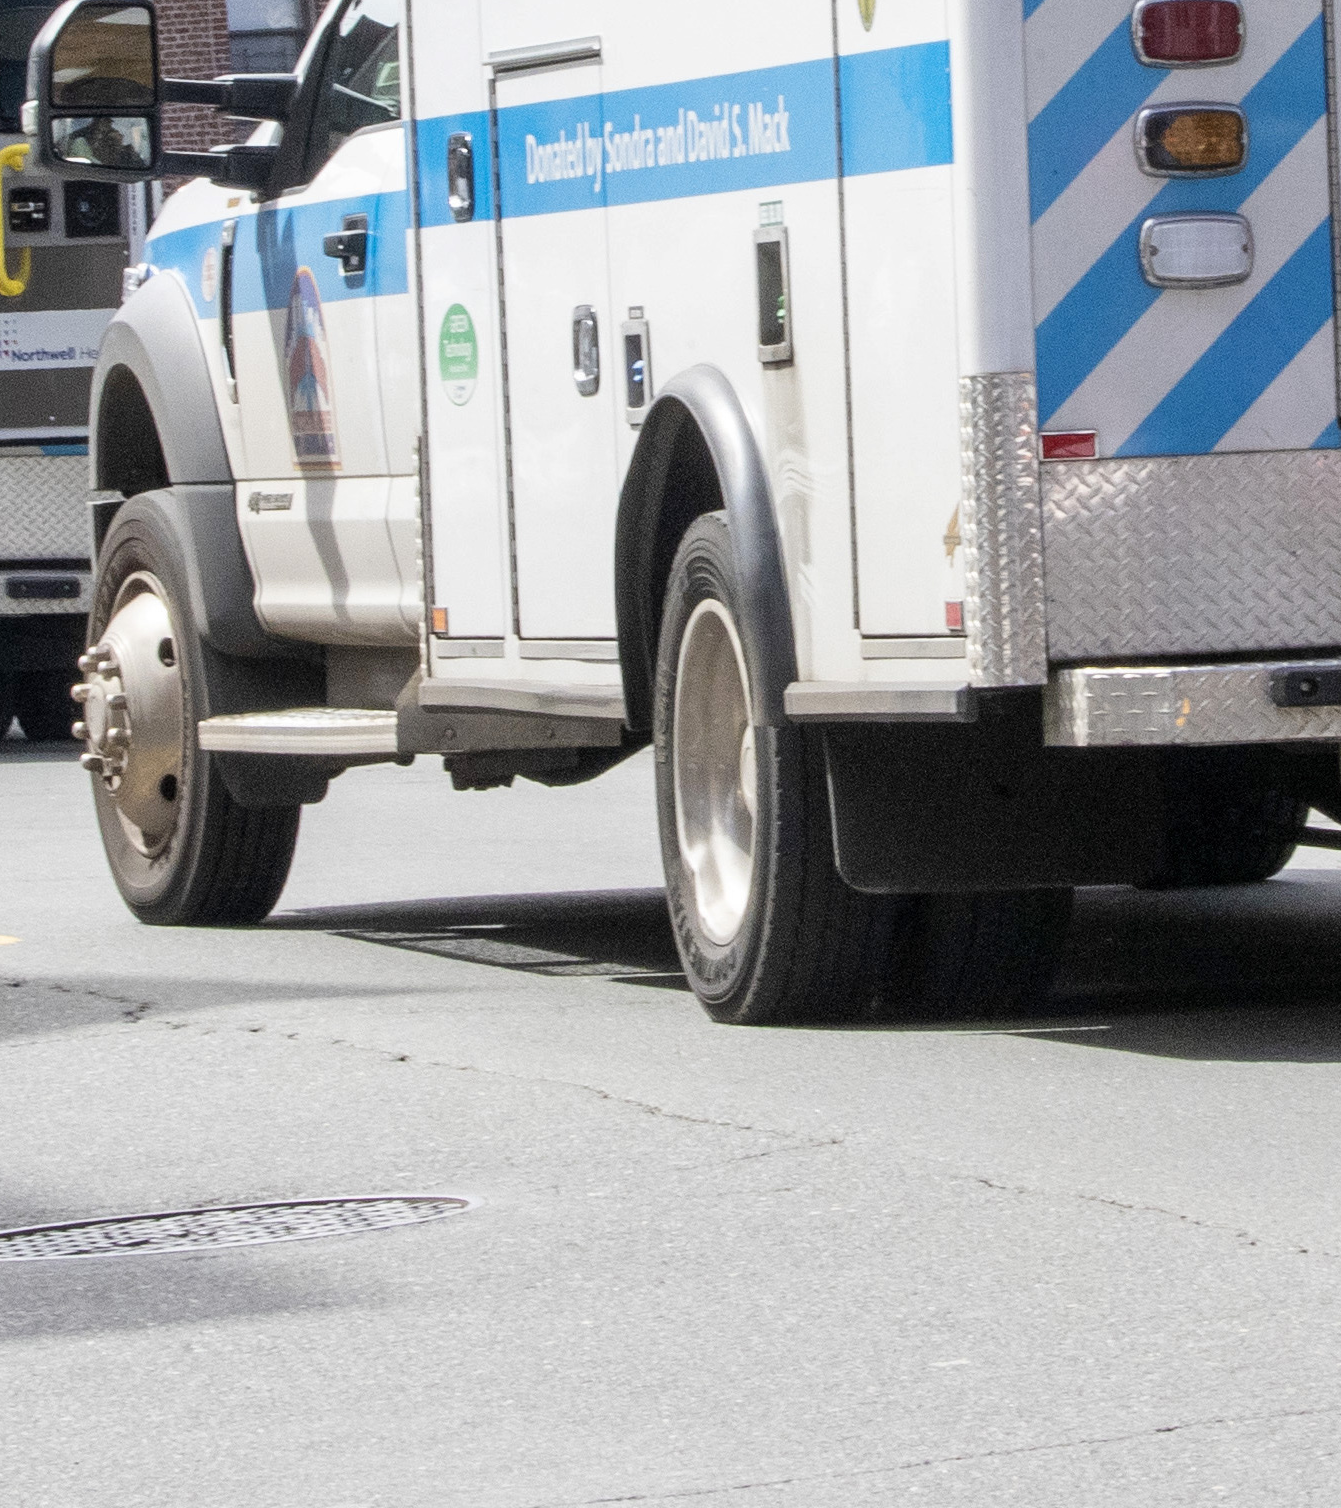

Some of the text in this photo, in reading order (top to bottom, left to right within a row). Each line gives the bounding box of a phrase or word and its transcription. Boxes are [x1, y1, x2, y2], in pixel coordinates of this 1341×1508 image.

[525, 95, 791, 193] Donated by Sondra and David S. Mack
[11, 346, 76, 362] Northwell
